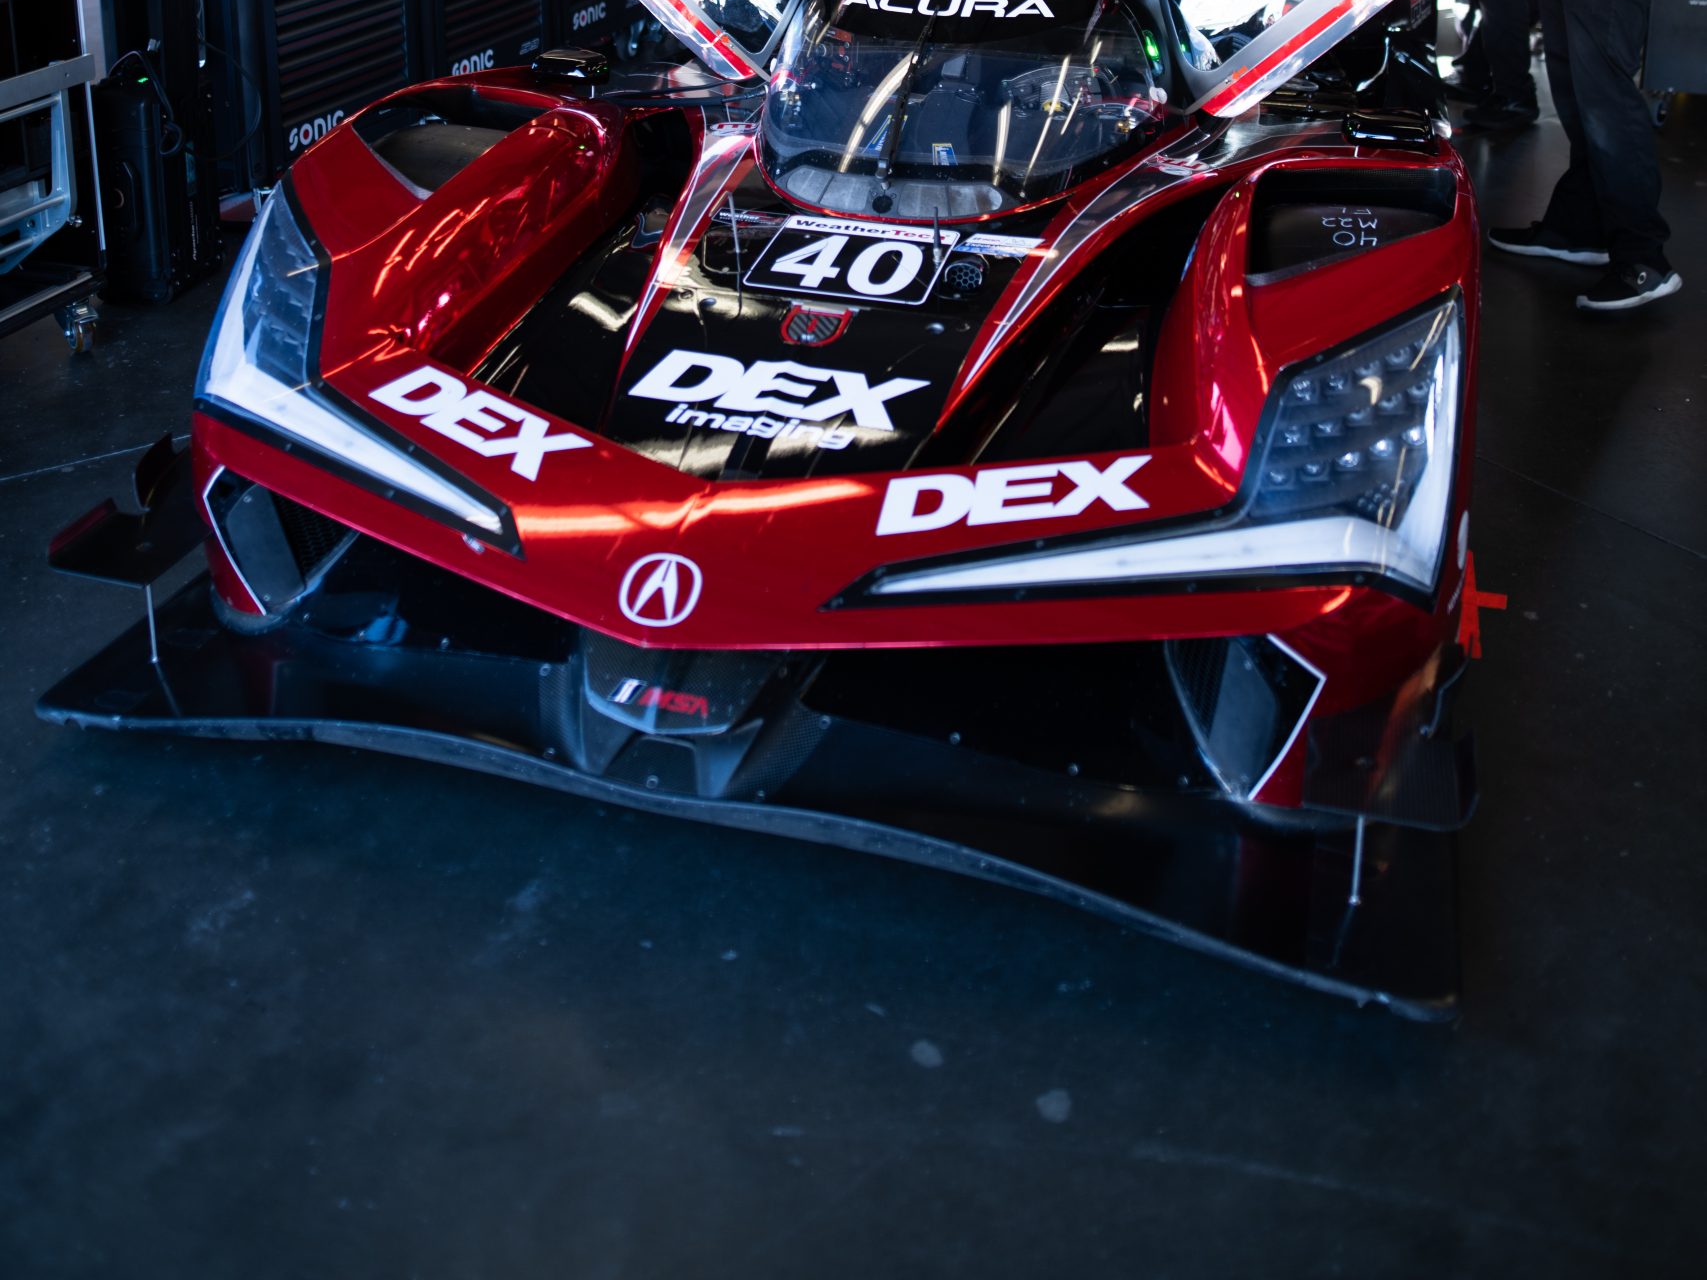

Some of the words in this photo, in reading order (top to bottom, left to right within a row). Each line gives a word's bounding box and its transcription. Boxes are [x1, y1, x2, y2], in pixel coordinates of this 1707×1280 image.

[572, 2, 607, 31] SONIC
[451, 49, 494, 76] SONIC
[771, 235, 923, 296] 40
[628, 349, 931, 431] DEX
[367, 364, 594, 482] DEX
[664, 402, 857, 450] imaging
[875, 454, 1152, 536] DEX
